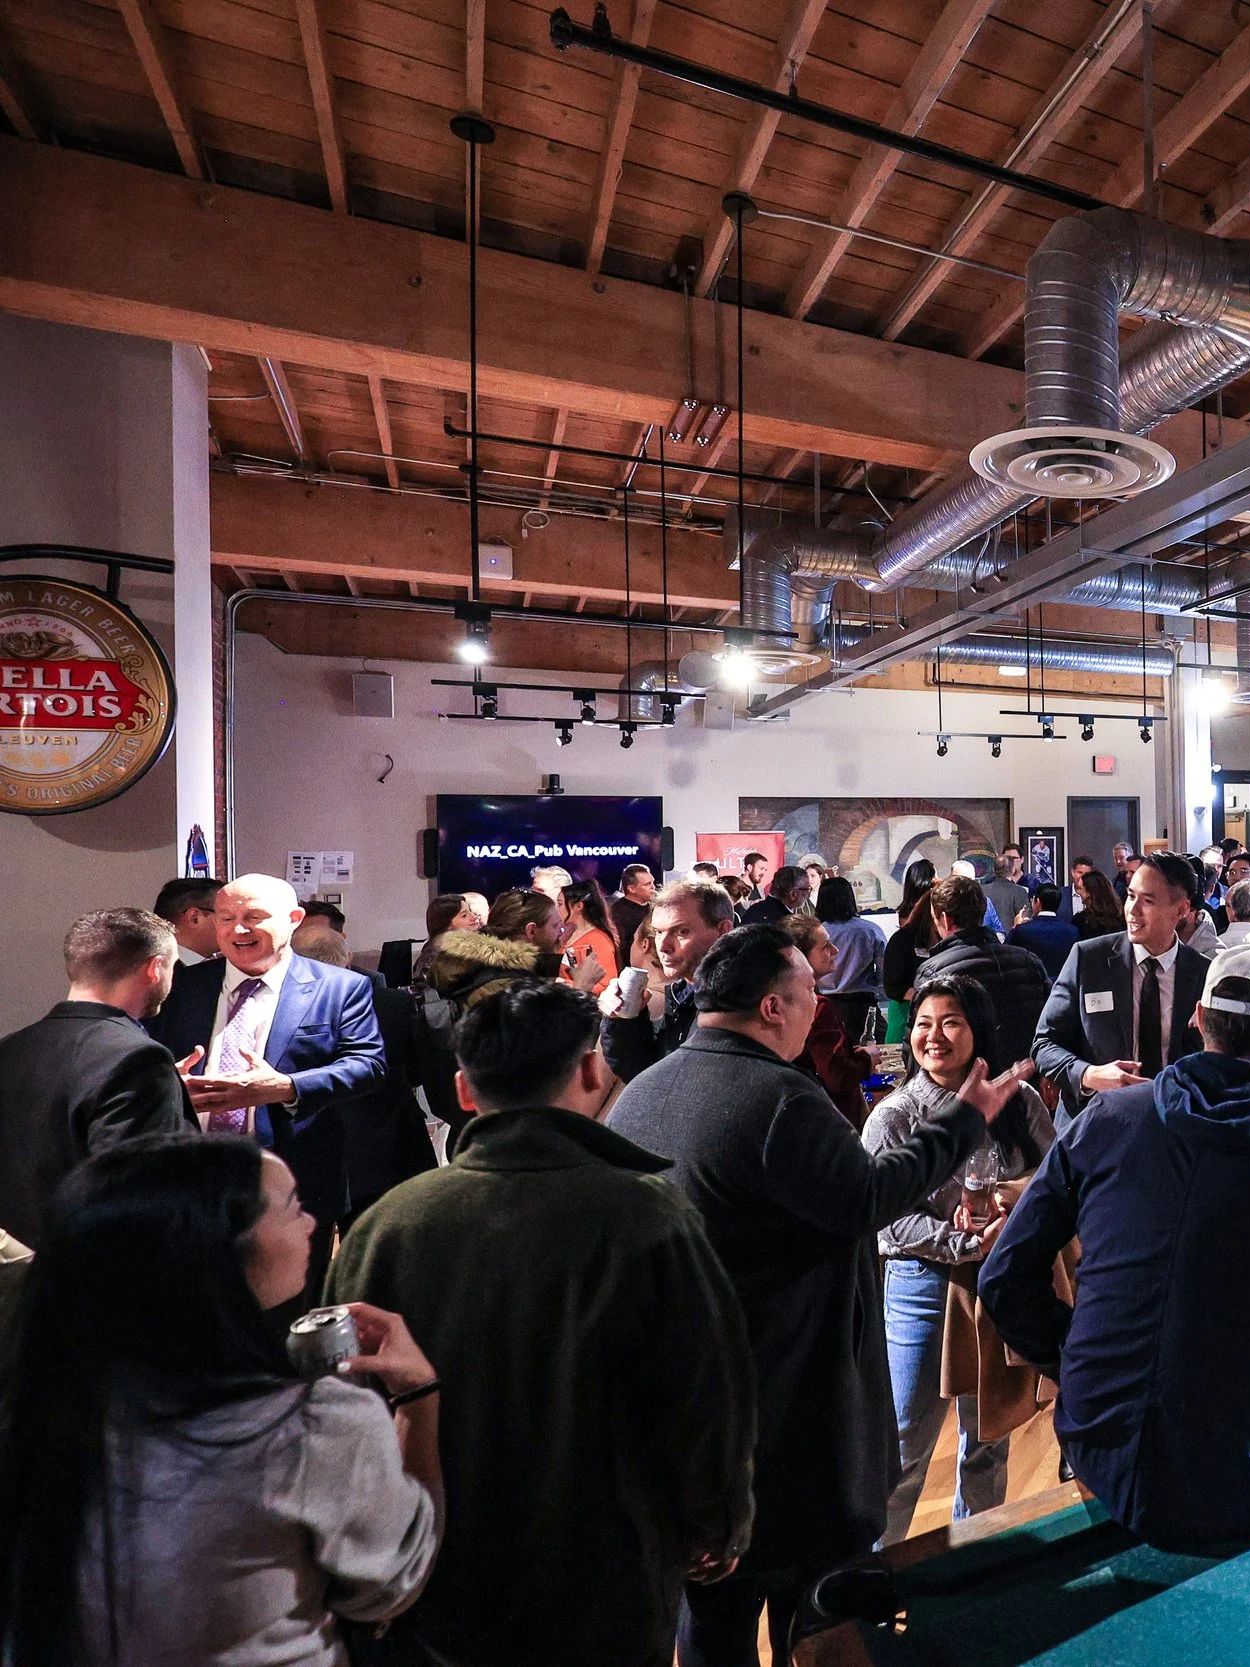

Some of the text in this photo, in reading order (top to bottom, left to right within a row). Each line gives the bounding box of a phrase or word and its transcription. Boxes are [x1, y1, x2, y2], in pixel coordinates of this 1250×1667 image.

[28, 590, 95, 617] LAGER
[98, 617, 136, 653] BEER
[1, 666, 118, 692] ELLA
[27, 768, 115, 800] ORIGINAL
[109, 737, 142, 770] BEER
[466, 844, 639, 860] NAZ_CA_Pub Vancouver
[717, 856, 745, 869] ULT
